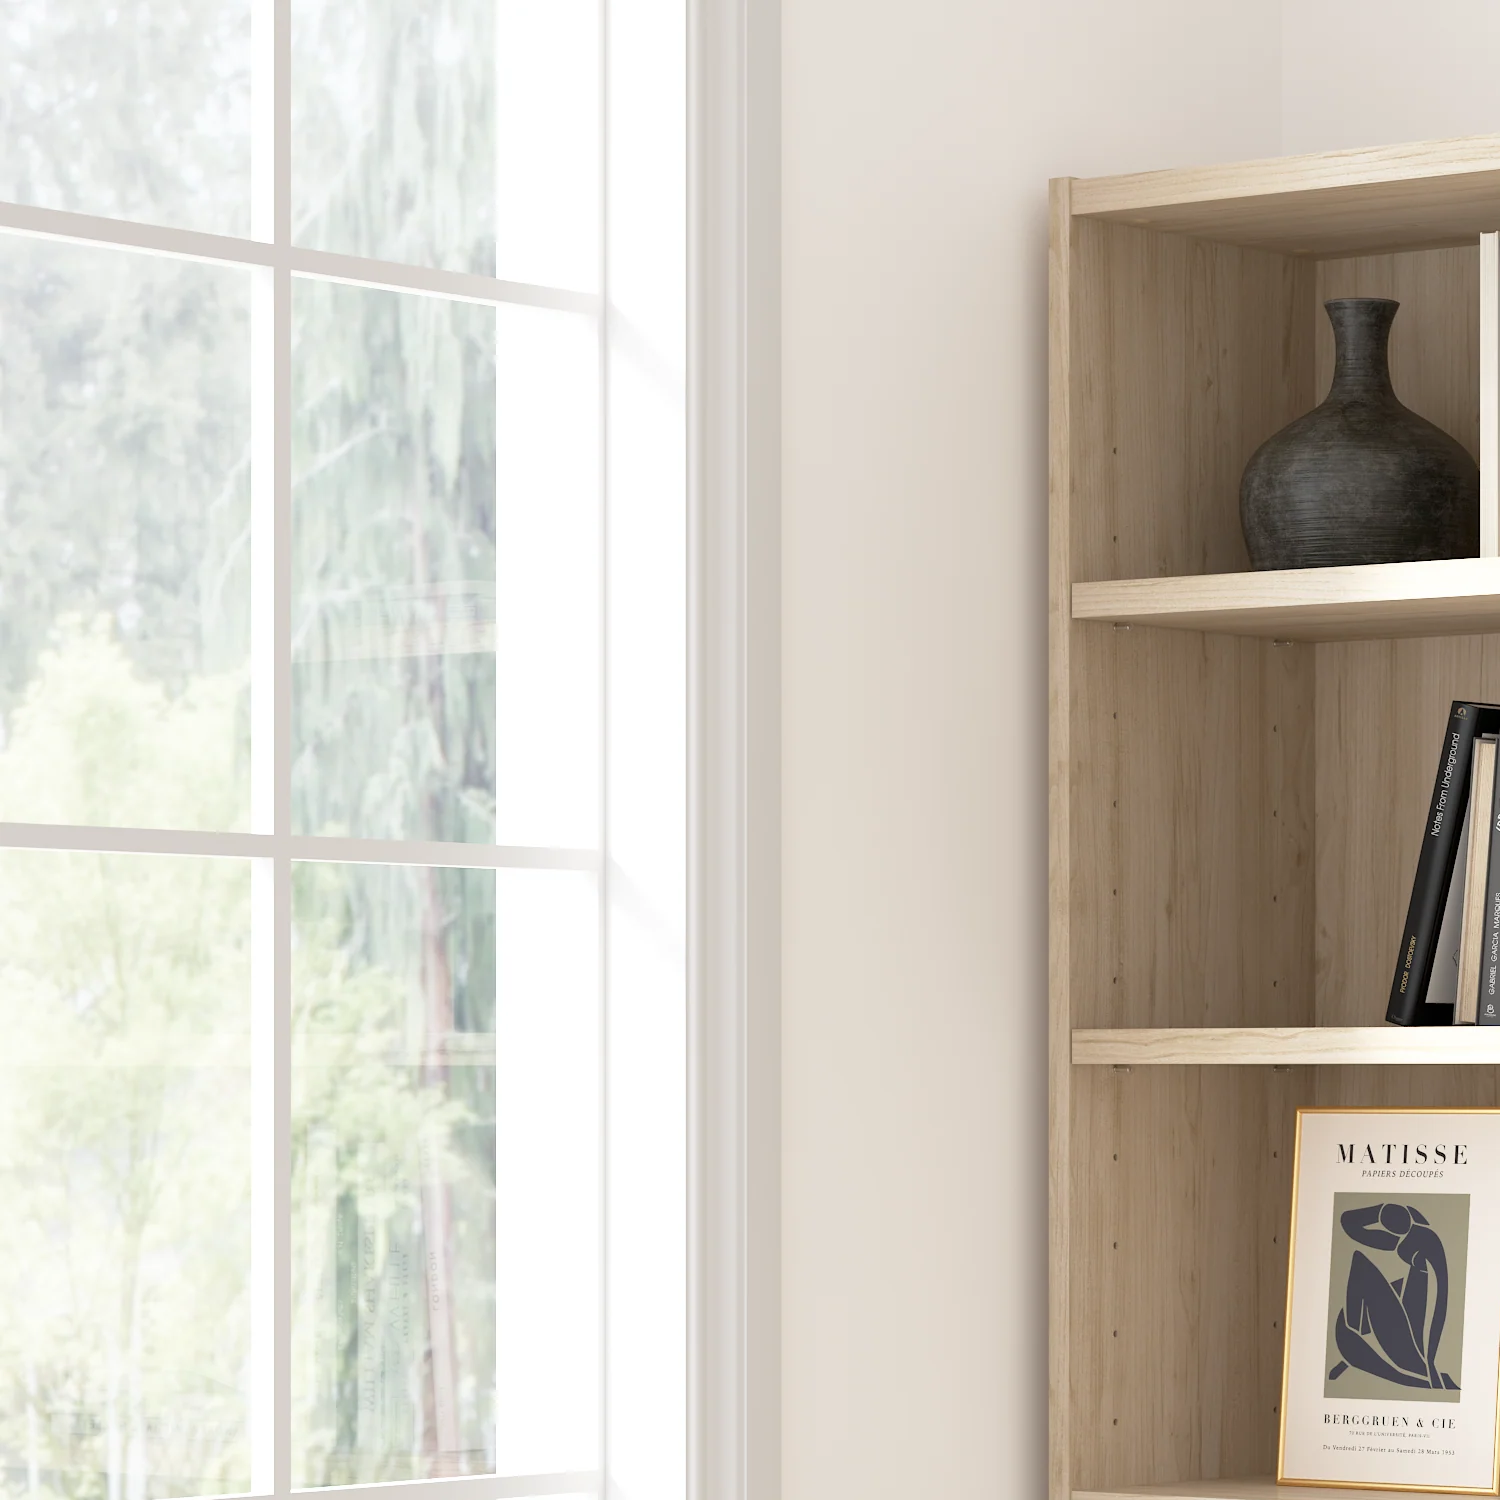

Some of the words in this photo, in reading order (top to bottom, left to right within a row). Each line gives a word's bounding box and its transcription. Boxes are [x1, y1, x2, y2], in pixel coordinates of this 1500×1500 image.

[1443, 733, 1460, 788] Underground
[1437, 787, 1449, 810] From
[1431, 810, 1444, 837] Notes
[1488, 965, 1497, 995] GABRIEL
[1336, 1142, 1469, 1165] MATISSE
[1361, 1169, 1395, 1178] PAPIERS
[1399, 1169, 1444, 1179] DÉCOUPÉS
[1323, 1413, 1409, 1428] BERGGRUEN
[1416, 1419, 1423, 1428] &
[1432, 1418, 1456, 1429] CIE
